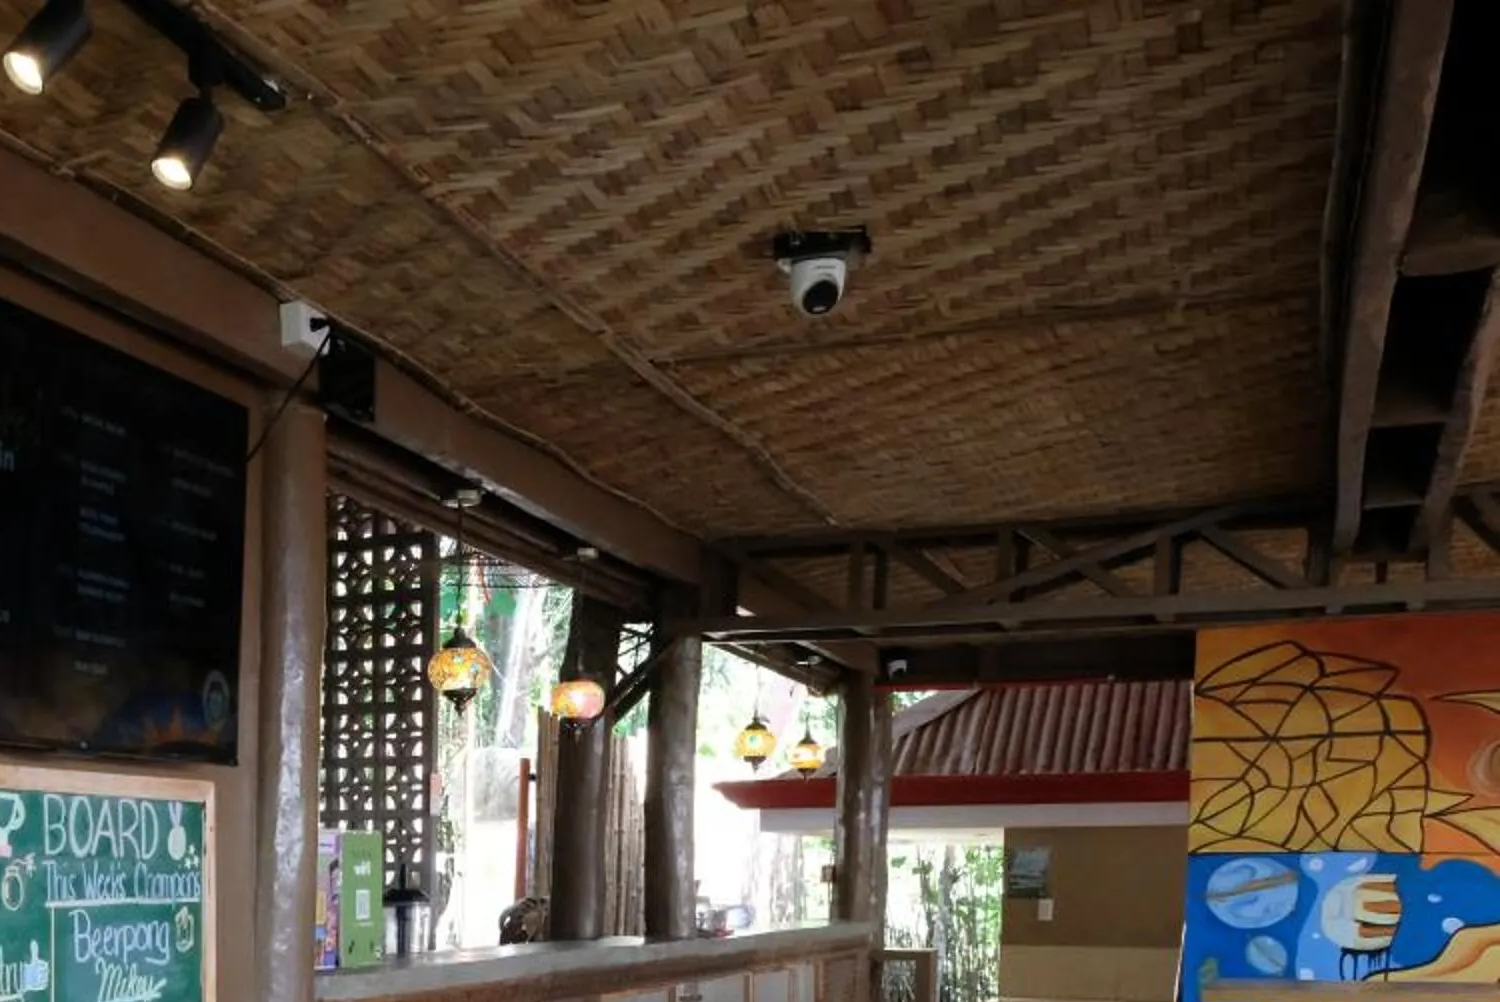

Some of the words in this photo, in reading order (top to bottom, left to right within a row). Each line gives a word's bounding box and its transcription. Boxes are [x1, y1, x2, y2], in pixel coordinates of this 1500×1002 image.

[43, 794, 160, 860] BOARD
[42, 860, 77, 899] This
[69, 909, 170, 966] Beerpong
